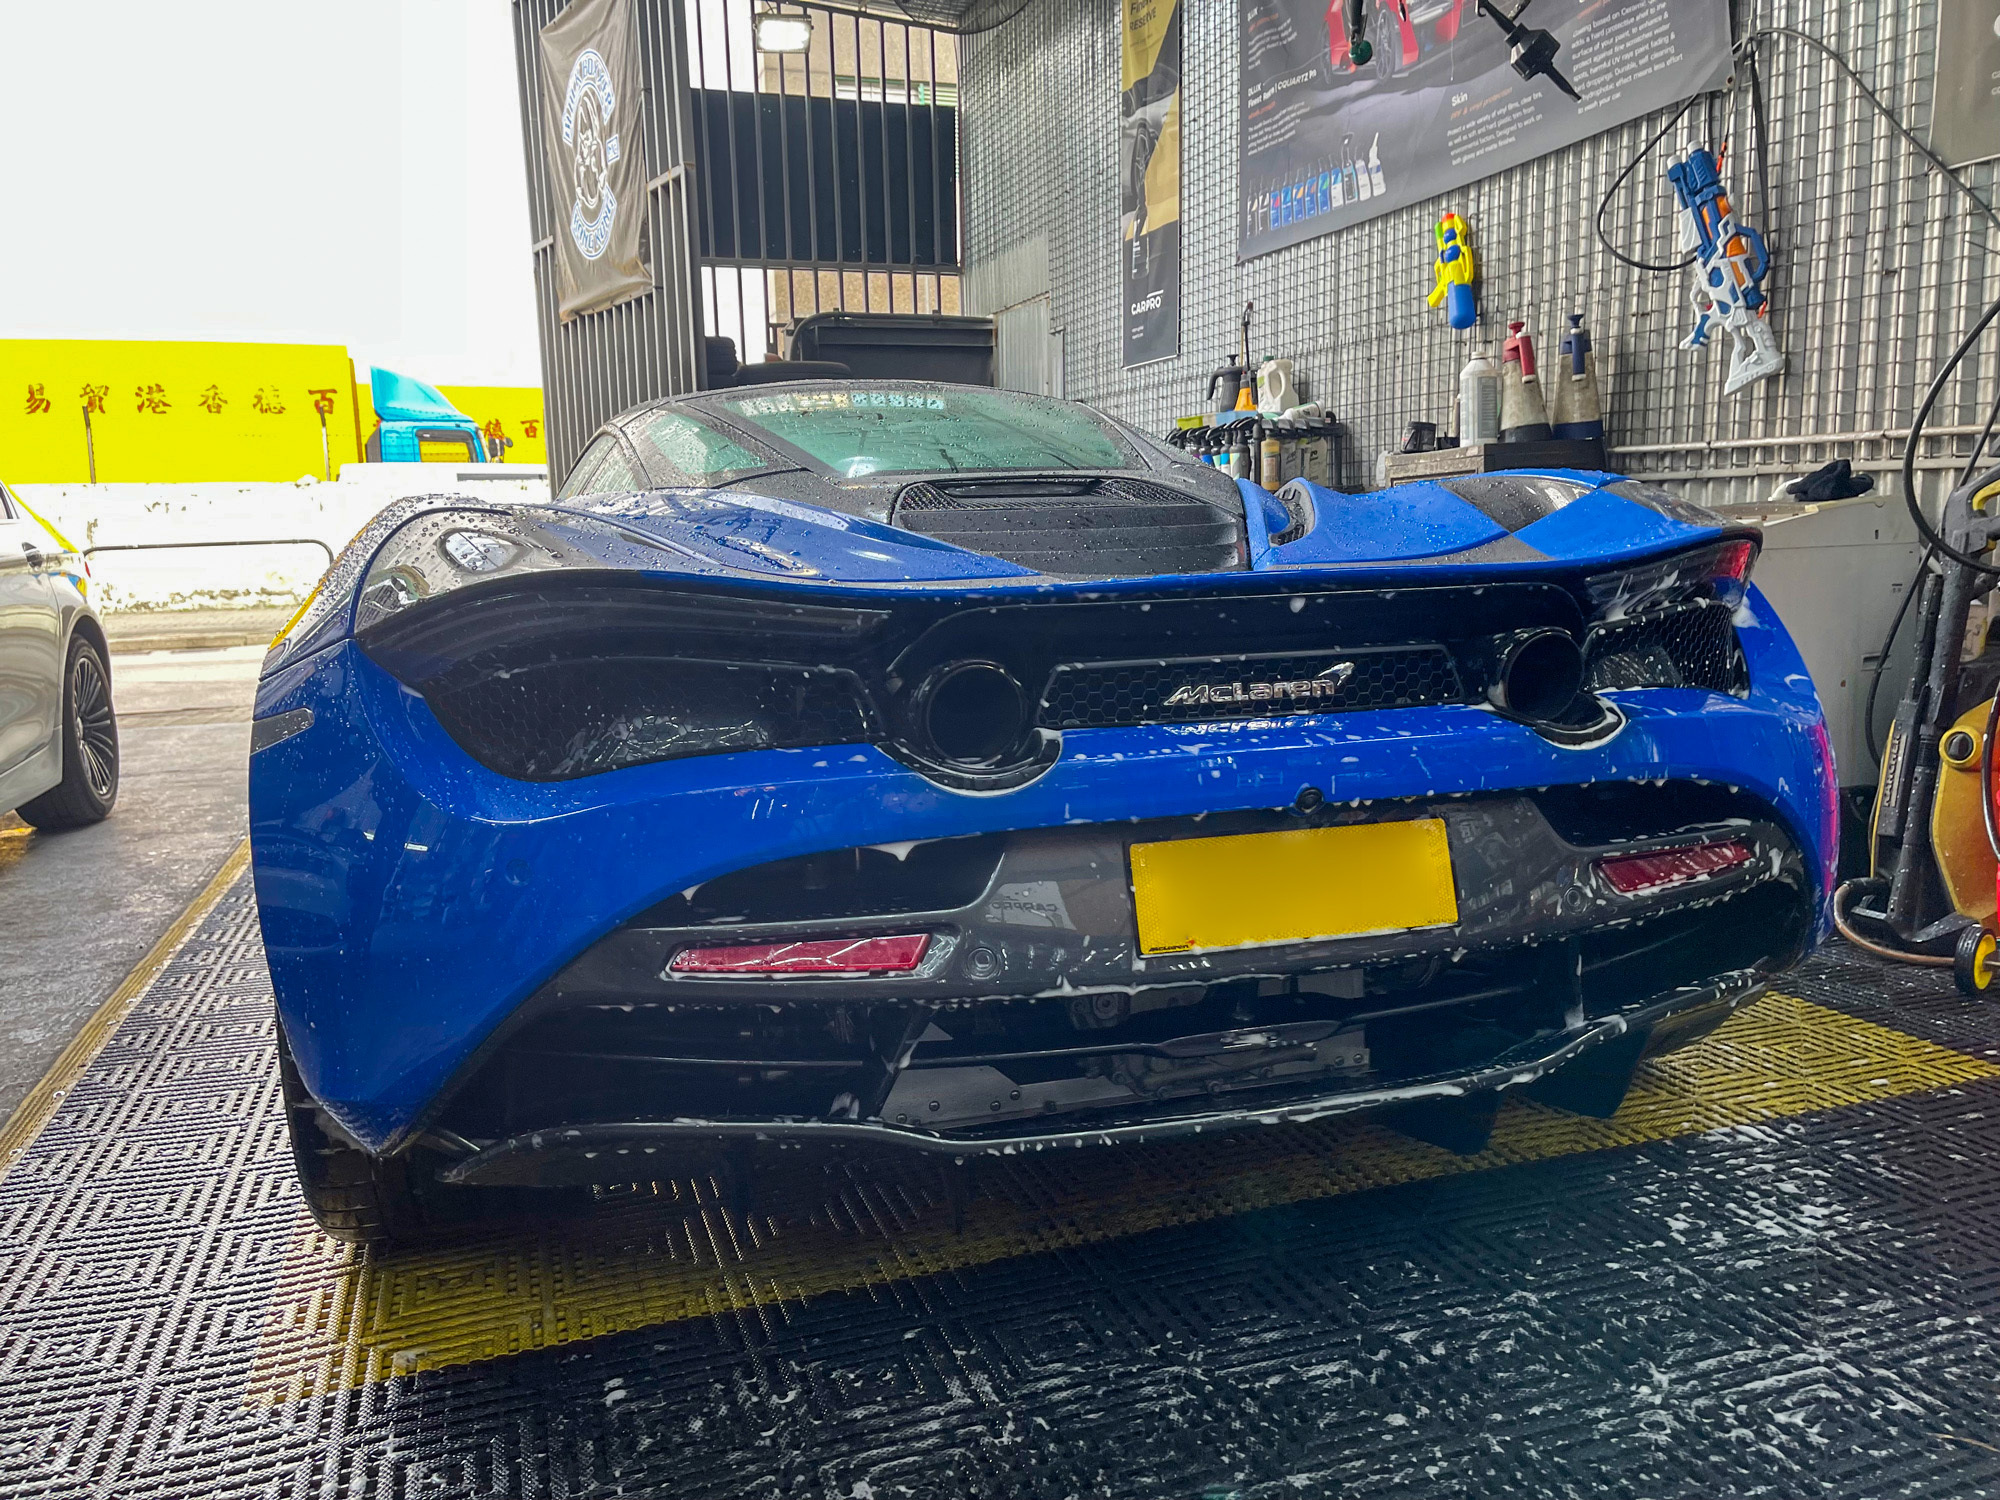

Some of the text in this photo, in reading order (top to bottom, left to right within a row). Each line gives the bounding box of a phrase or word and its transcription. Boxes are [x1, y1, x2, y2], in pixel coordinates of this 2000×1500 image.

[1451, 92, 1468, 107] Skin
[1131, 295, 1161, 315] CARPRO
[1163, 679, 1334, 706] McLaren
